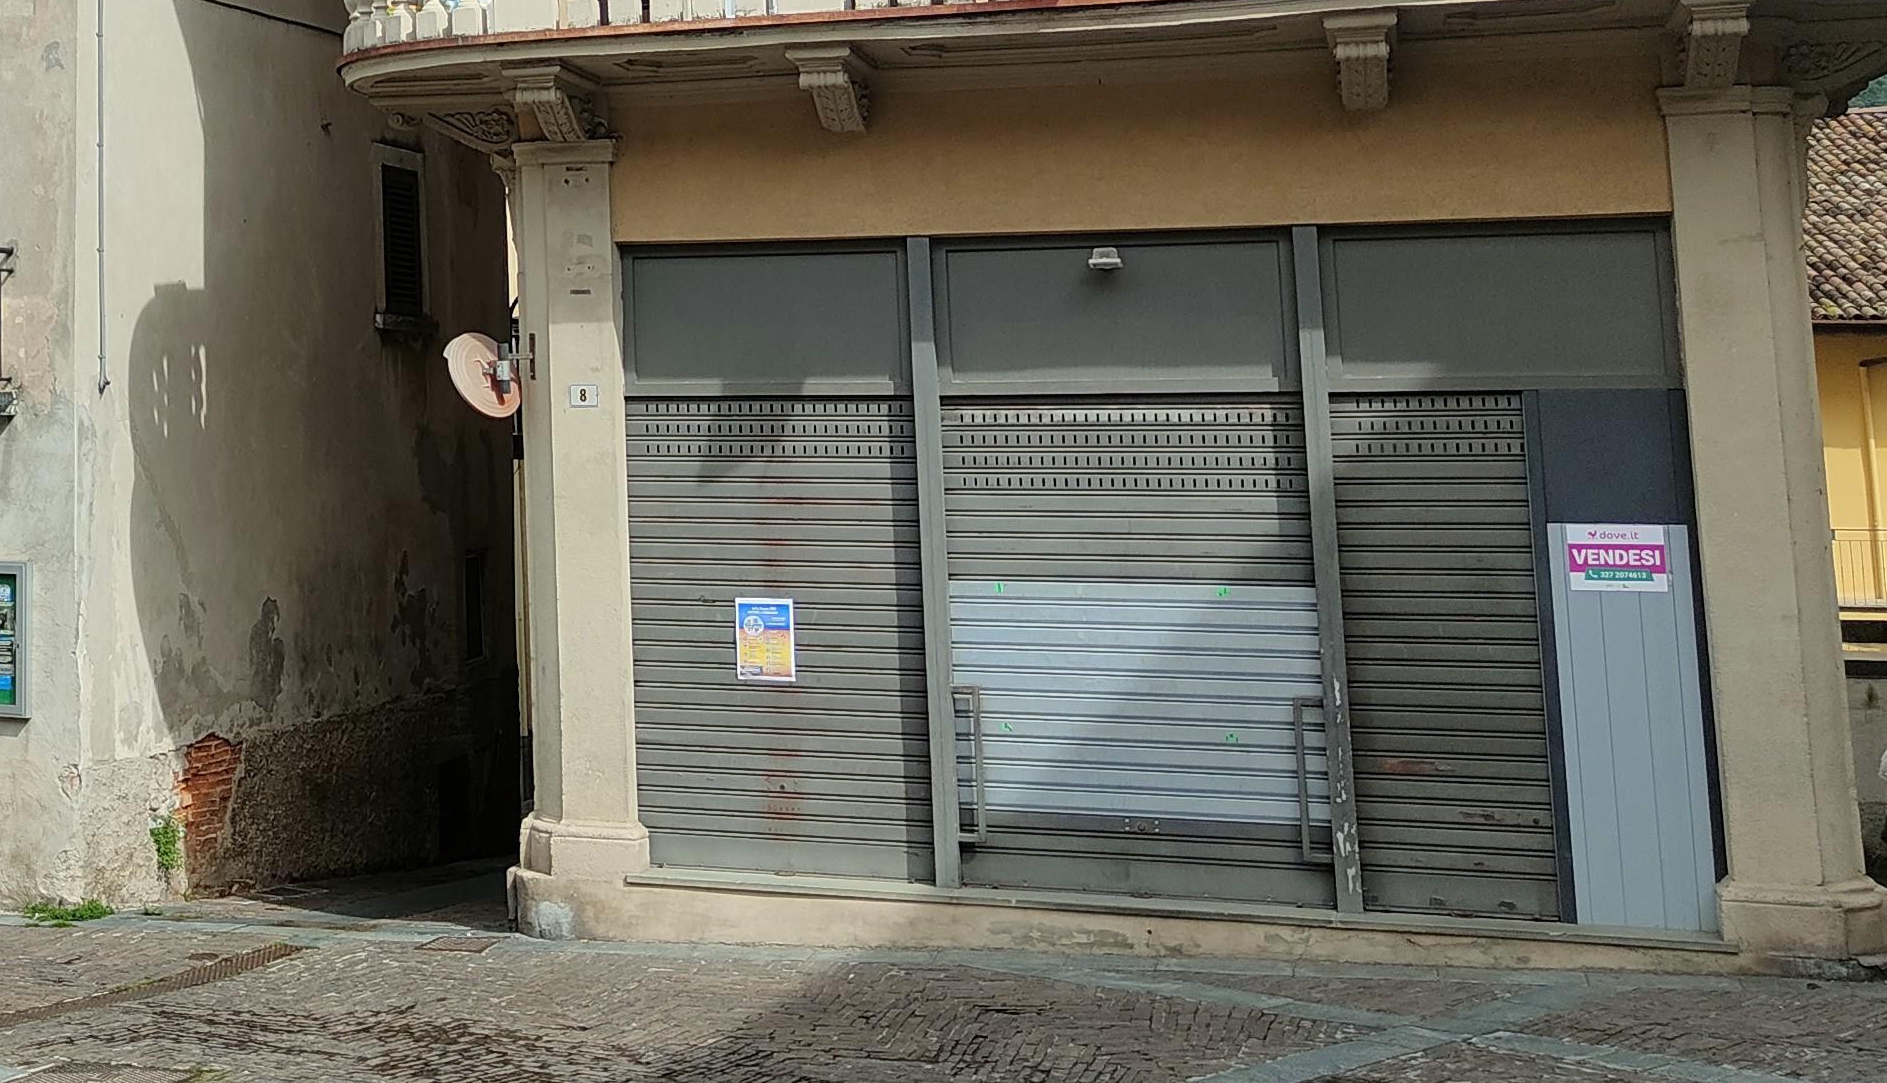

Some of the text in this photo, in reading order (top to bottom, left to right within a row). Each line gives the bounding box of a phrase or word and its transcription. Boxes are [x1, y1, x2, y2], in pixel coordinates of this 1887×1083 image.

[579, 388, 587, 402] 8
[1599, 530, 1639, 540] dove.it
[1571, 548, 1661, 566] VENDESI
